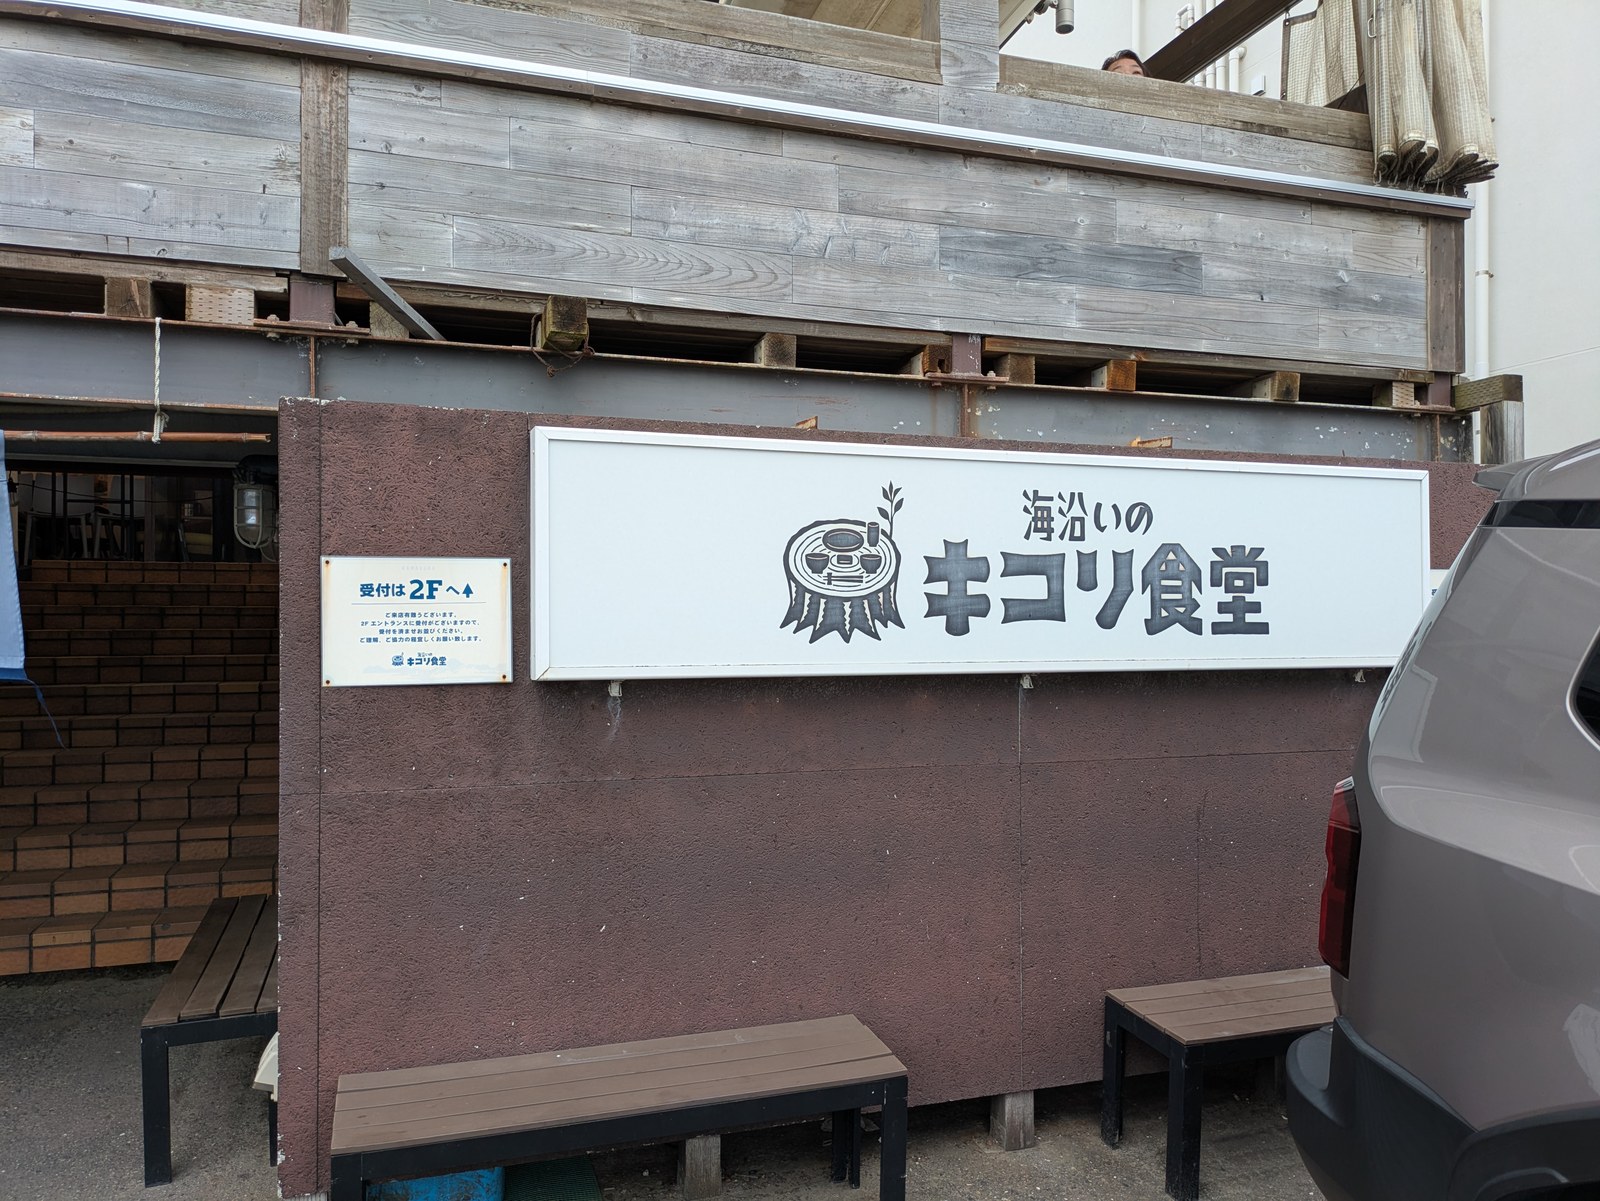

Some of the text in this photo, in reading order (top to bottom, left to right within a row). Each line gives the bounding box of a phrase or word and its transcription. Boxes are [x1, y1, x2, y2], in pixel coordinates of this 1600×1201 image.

[1022, 489, 1153, 541] 海沿いの
[923, 538, 1269, 636] キコリ食堂
[407, 656, 447, 666] キコリ食堂
